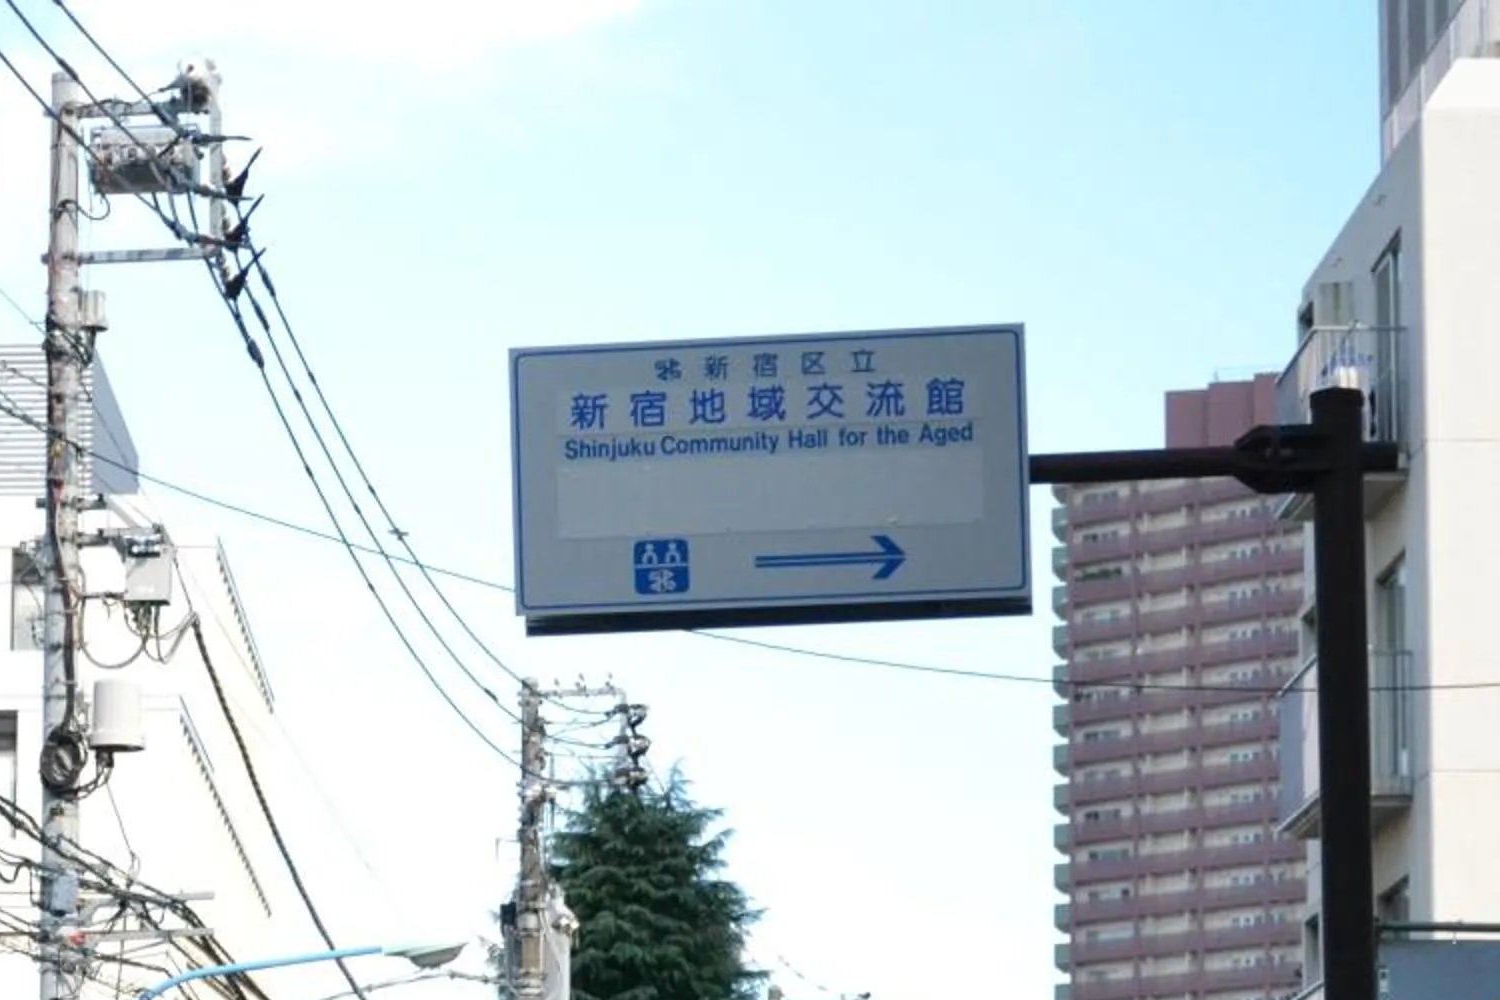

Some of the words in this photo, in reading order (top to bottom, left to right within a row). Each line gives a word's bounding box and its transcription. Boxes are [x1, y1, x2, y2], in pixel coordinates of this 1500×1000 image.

[704, 349, 876, 380] 新宿区立
[570, 376, 965, 430] 新宿地域交流館
[564, 437, 655, 461] Shinjuku
[660, 430, 779, 455] Community
[788, 428, 828, 449] Hall
[838, 424, 868, 446] for
[877, 422, 910, 446] the
[919, 421, 974, 446] Aged
